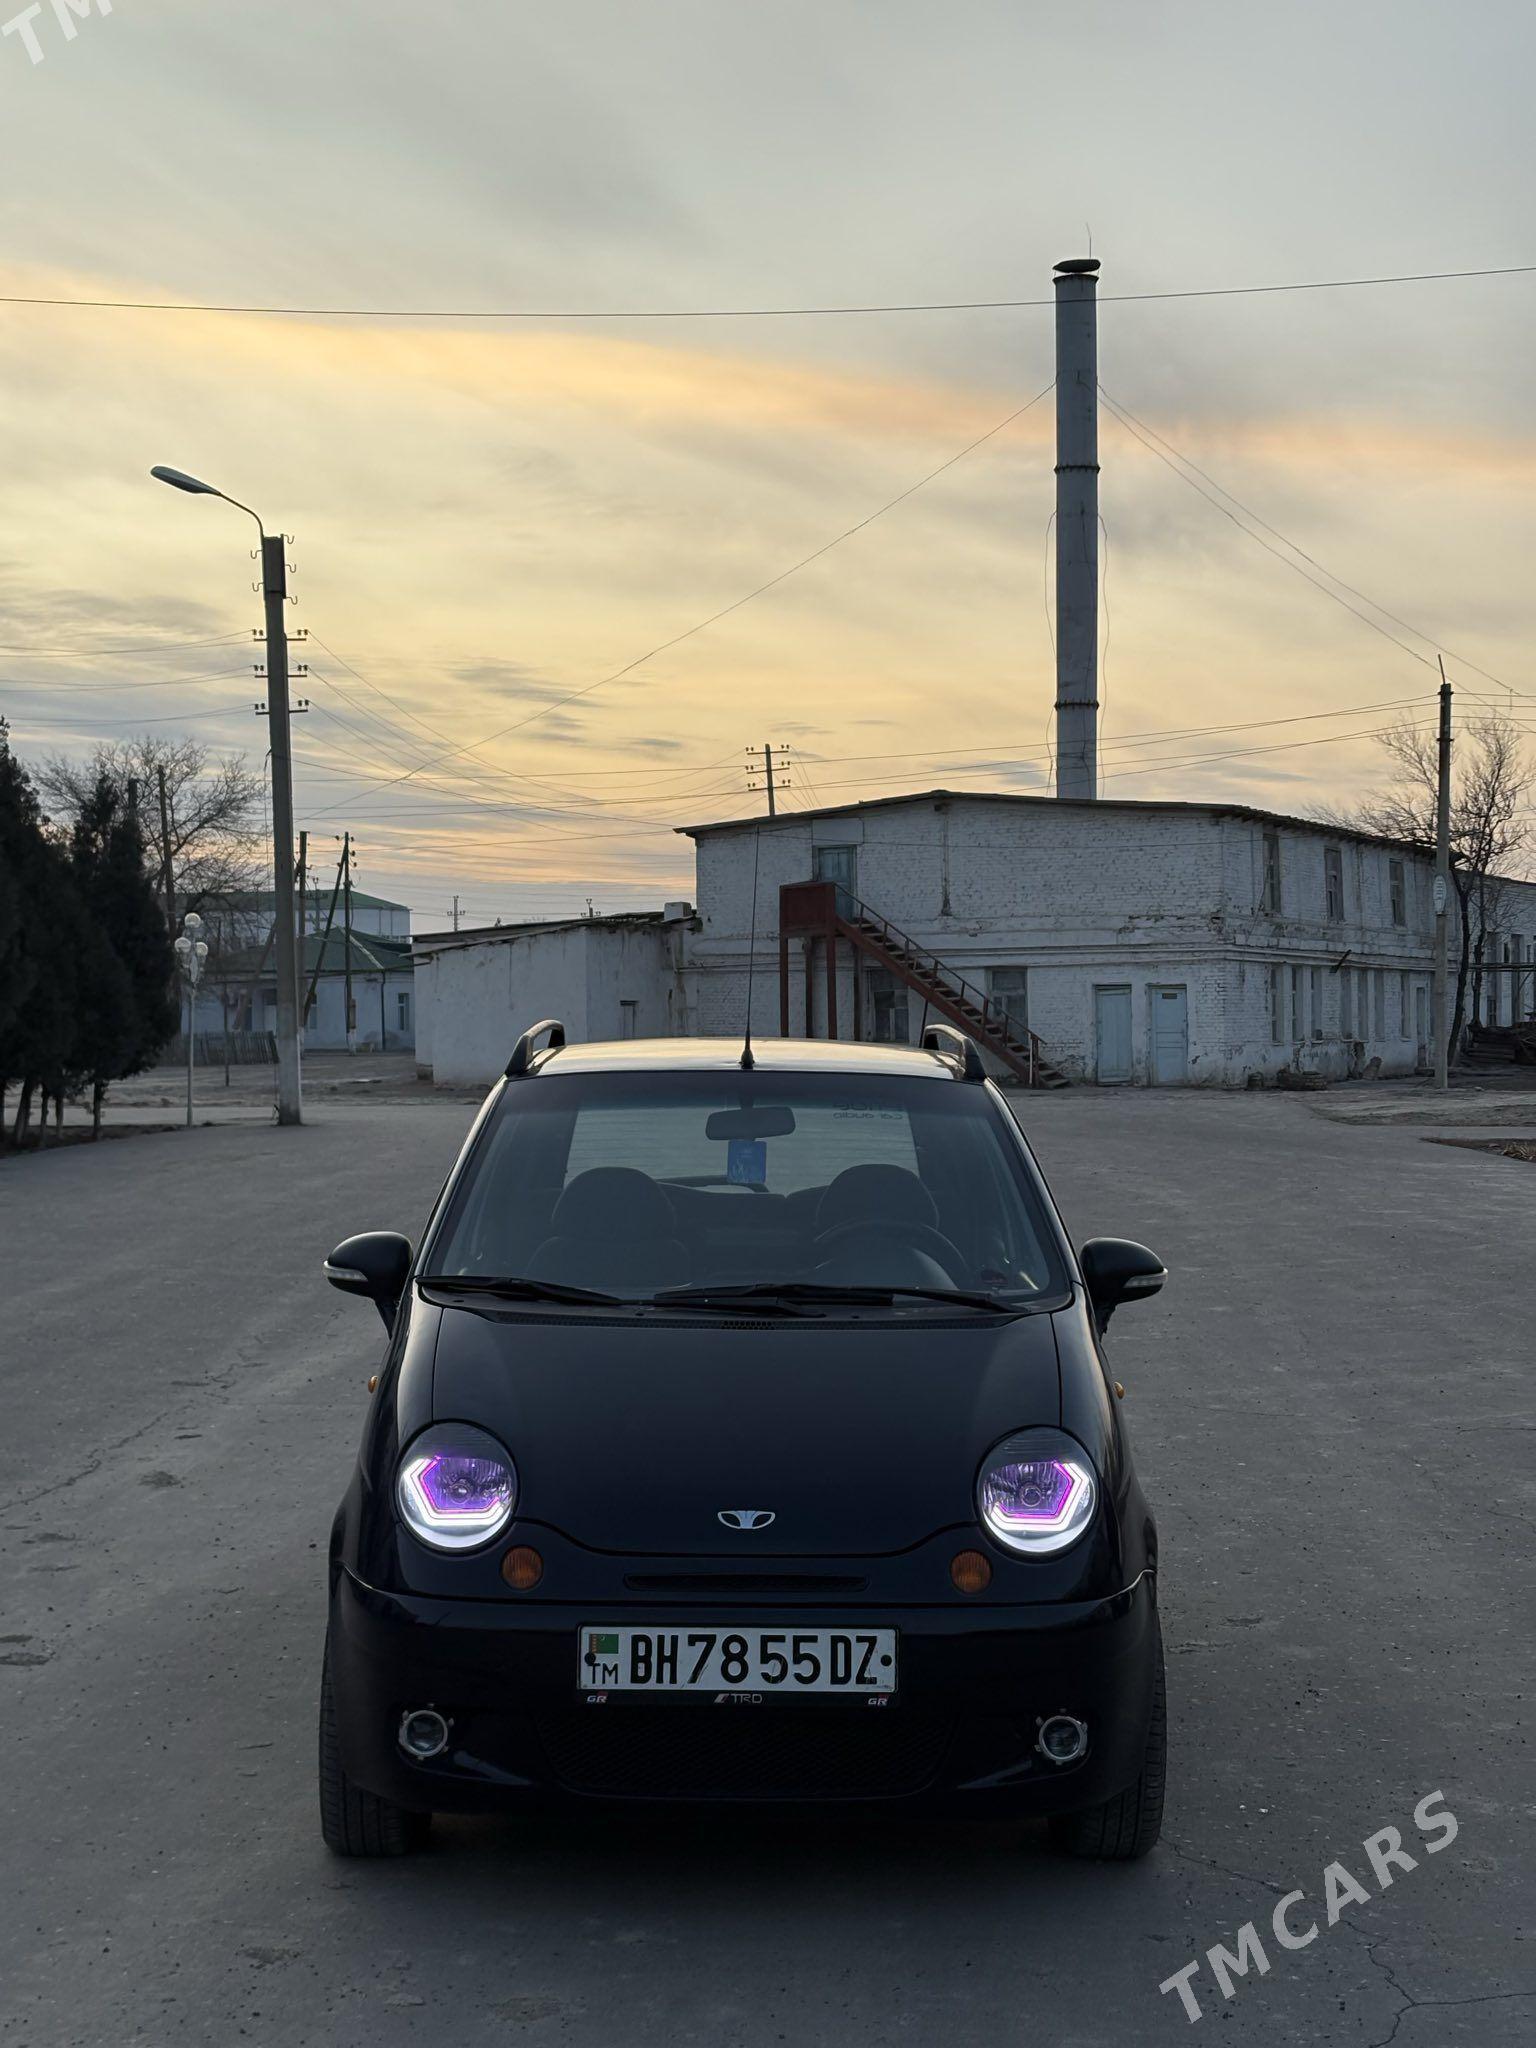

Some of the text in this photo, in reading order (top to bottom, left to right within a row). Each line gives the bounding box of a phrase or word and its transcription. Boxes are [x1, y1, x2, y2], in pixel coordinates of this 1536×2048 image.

[588, 1663, 618, 1684] TM
[586, 1695, 607, 1703] GR
[730, 1693, 763, 1704] TRD
[868, 1698, 888, 1706] GR
